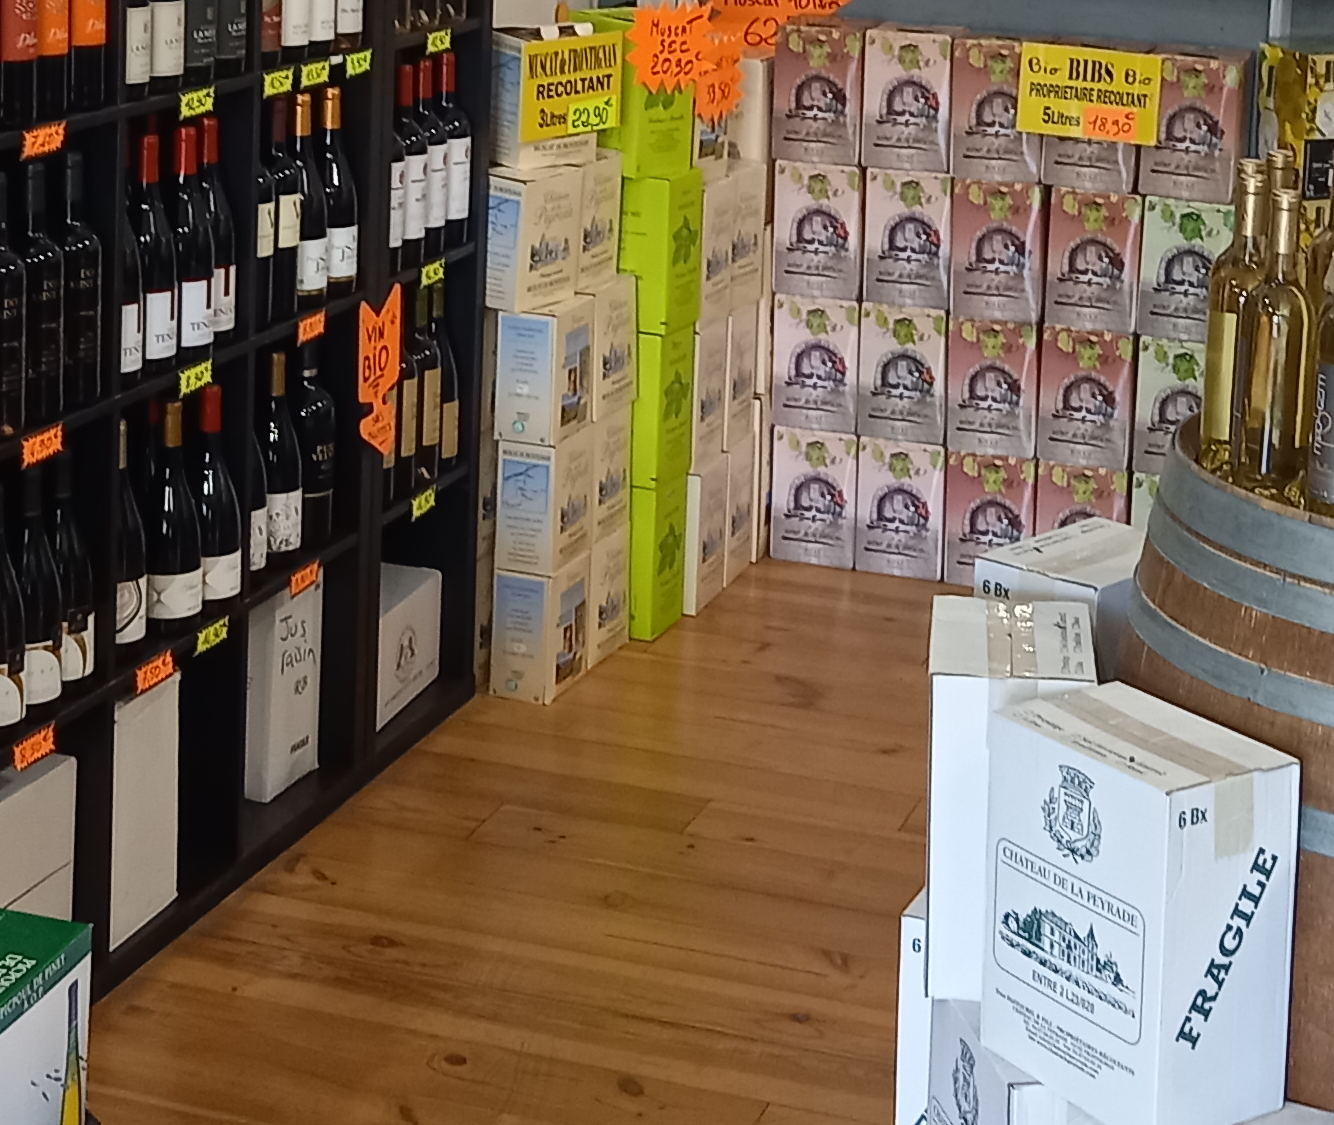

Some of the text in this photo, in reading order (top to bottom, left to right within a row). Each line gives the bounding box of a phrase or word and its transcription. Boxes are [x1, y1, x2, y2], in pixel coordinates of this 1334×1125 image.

[1028, 56, 1154, 86] Bio BIBS Bio
[536, 73, 614, 101] RECOLTANT
[1029, 81, 1149, 110] PROPRIETAIRE RECOLTANT
[982, 579, 991, 595] 6
[1178, 810, 1188, 829] 6
[1002, 845, 1138, 928] CHATEAU DE LA PEYRADE
[1175, 846, 1279, 1051] FRAGILE
